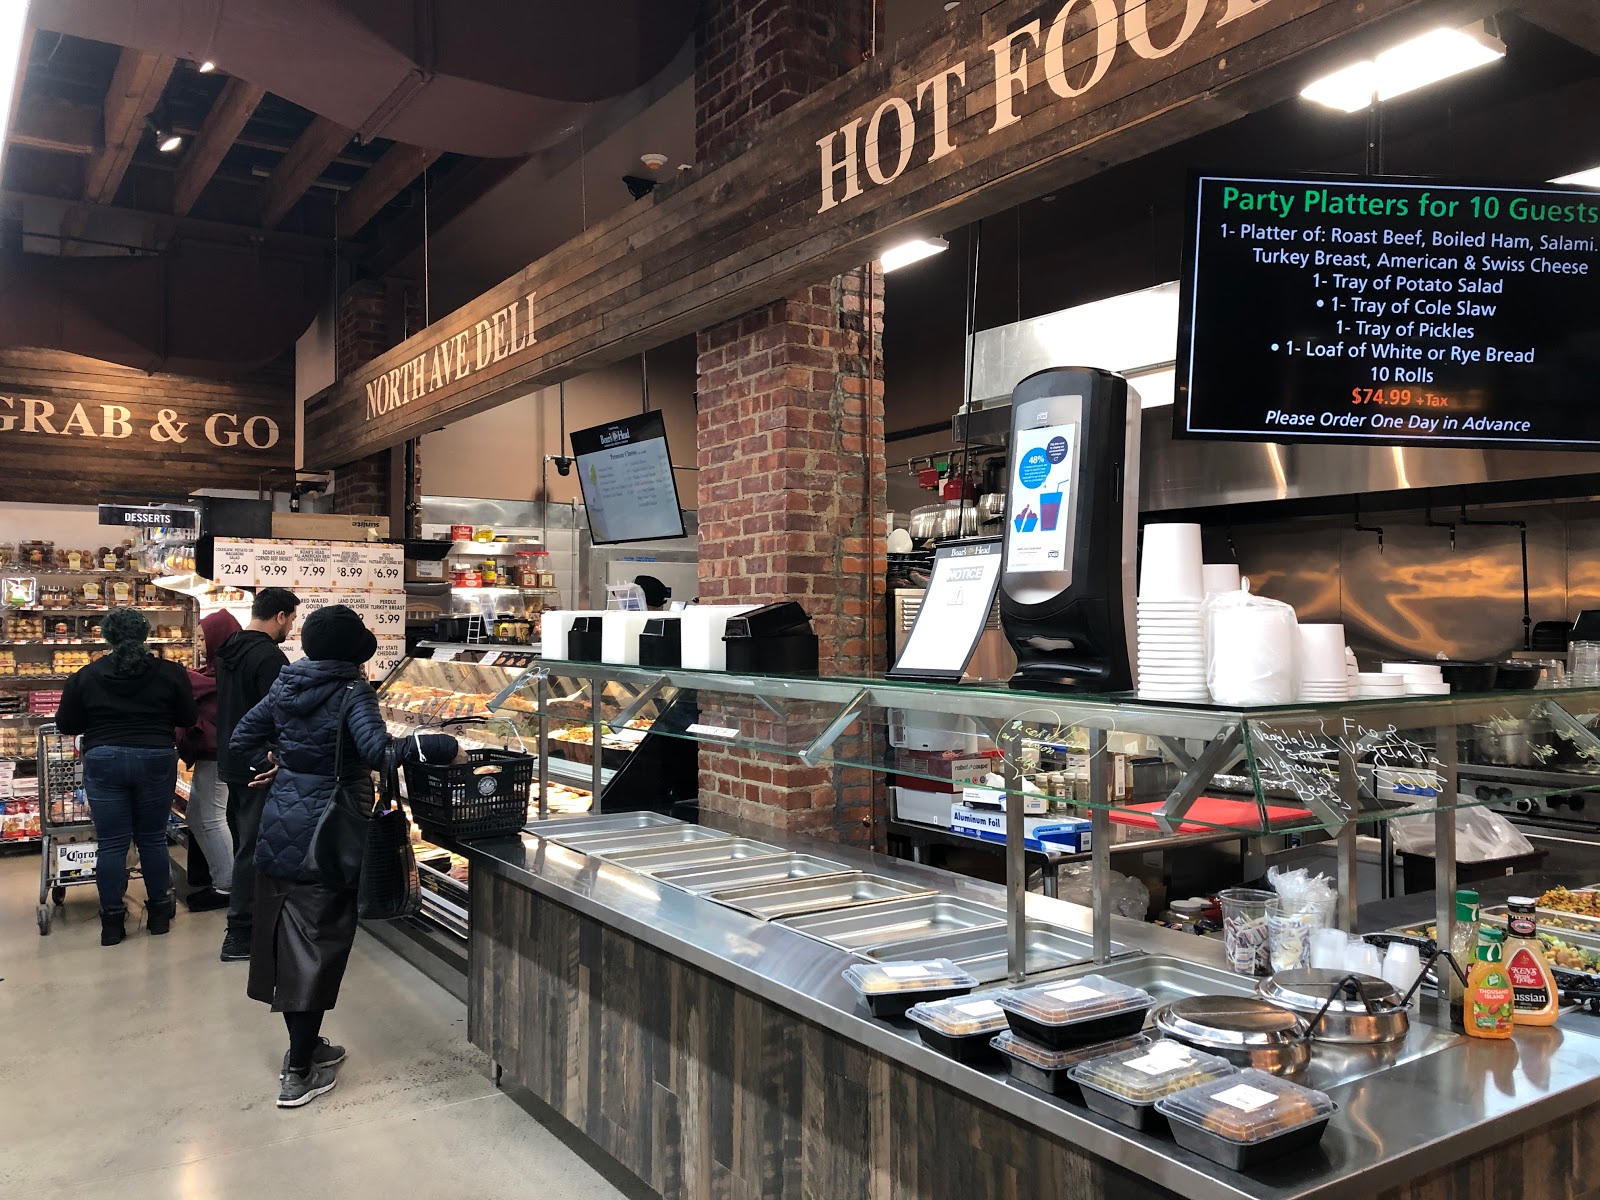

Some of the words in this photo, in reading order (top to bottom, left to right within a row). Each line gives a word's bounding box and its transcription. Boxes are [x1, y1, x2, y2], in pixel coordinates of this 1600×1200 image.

[816, 61, 966, 214] HOT
[988, 0, 1272, 135] FOO
[1223, 187, 1294, 218] Party
[1304, 190, 1408, 216] Platters
[1418, 193, 1458, 217] for
[1471, 196, 1499, 218] 10
[1509, 198, 1598, 223] Guests
[1220, 224, 1235, 238] 1-
[1241, 224, 1297, 241] Platter
[1303, 226, 1326, 242] of:
[1332, 228, 1377, 244] Roast
[1383, 228, 1425, 247] Beef,
[1432, 231, 1486, 248] Boiled
[1491, 233, 1533, 251] Ham,
[1253, 247, 1309, 268] Turkey
[1314, 251, 1371, 269] Breast,
[1377, 253, 1458, 270] American
[1465, 256, 1476, 270] &
[1482, 256, 1524, 273] Swiss
[1530, 257, 1588, 274] Cheese
[1313, 274, 1327, 288] 1-
[1333, 275, 1368, 291] Tray
[1373, 275, 1392, 290] of
[1396, 276, 1452, 292] Potato
[1458, 278, 1503, 293] Salad
[1332, 297, 1346, 310] 1-
[1351, 298, 1386, 315] Tray
[1391, 298, 1410, 314] of
[1415, 299, 1451, 316] Cole
[1457, 301, 1496, 317] Slaw
[1337, 320, 1350, 334] 1-
[1356, 321, 1391, 339] Tray
[1396, 321, 1414, 337] of
[1419, 322, 1474, 339] Pickles
[365, 353, 427, 421] NORTH
[429, 329, 470, 393] AVE
[475, 291, 537, 371] DELI
[1286, 341, 1300, 355] 1-
[1306, 341, 1343, 358] Loaf
[1348, 342, 1367, 358] of
[1371, 343, 1422, 361] White
[1428, 347, 1445, 361] or
[1451, 346, 1481, 365] Rye
[1486, 347, 1534, 363] Bread
[1371, 367, 1389, 381] 10
[1394, 367, 1433, 383] Rolls
[1352, 387, 1411, 406] $74.99
[1417, 393, 1448, 407] +Tax
[150, 408, 188, 443] &
[204, 413, 279, 449] GO
[1265, 410, 1314, 427] Please
[1320, 412, 1366, 428] Order
[1371, 414, 1402, 429] One
[1408, 415, 1440, 433] Day
[1443, 416, 1457, 430] in
[1462, 416, 1530, 432] Advance
[1028, 454, 1045, 464] 48%
[124, 512, 171, 524] DESSERTS
[975, 545, 991, 554] Head
[221, 564, 248, 575] $2.49
[261, 565, 287, 575] $9.99
[300, 566, 325, 576] $7.99
[337, 567, 362, 577] $8.99
[374, 568, 398, 578] $6.99
[947, 567, 983, 581] NOTICE
[375, 614, 400, 624] $5.99
[375, 660, 400, 670] $4.99
[954, 812, 987, 825] Aluminum
[988, 818, 1001, 828] Foil
[1511, 967, 1537, 976] KEN'S
[1513, 992, 1546, 1003] ussian
